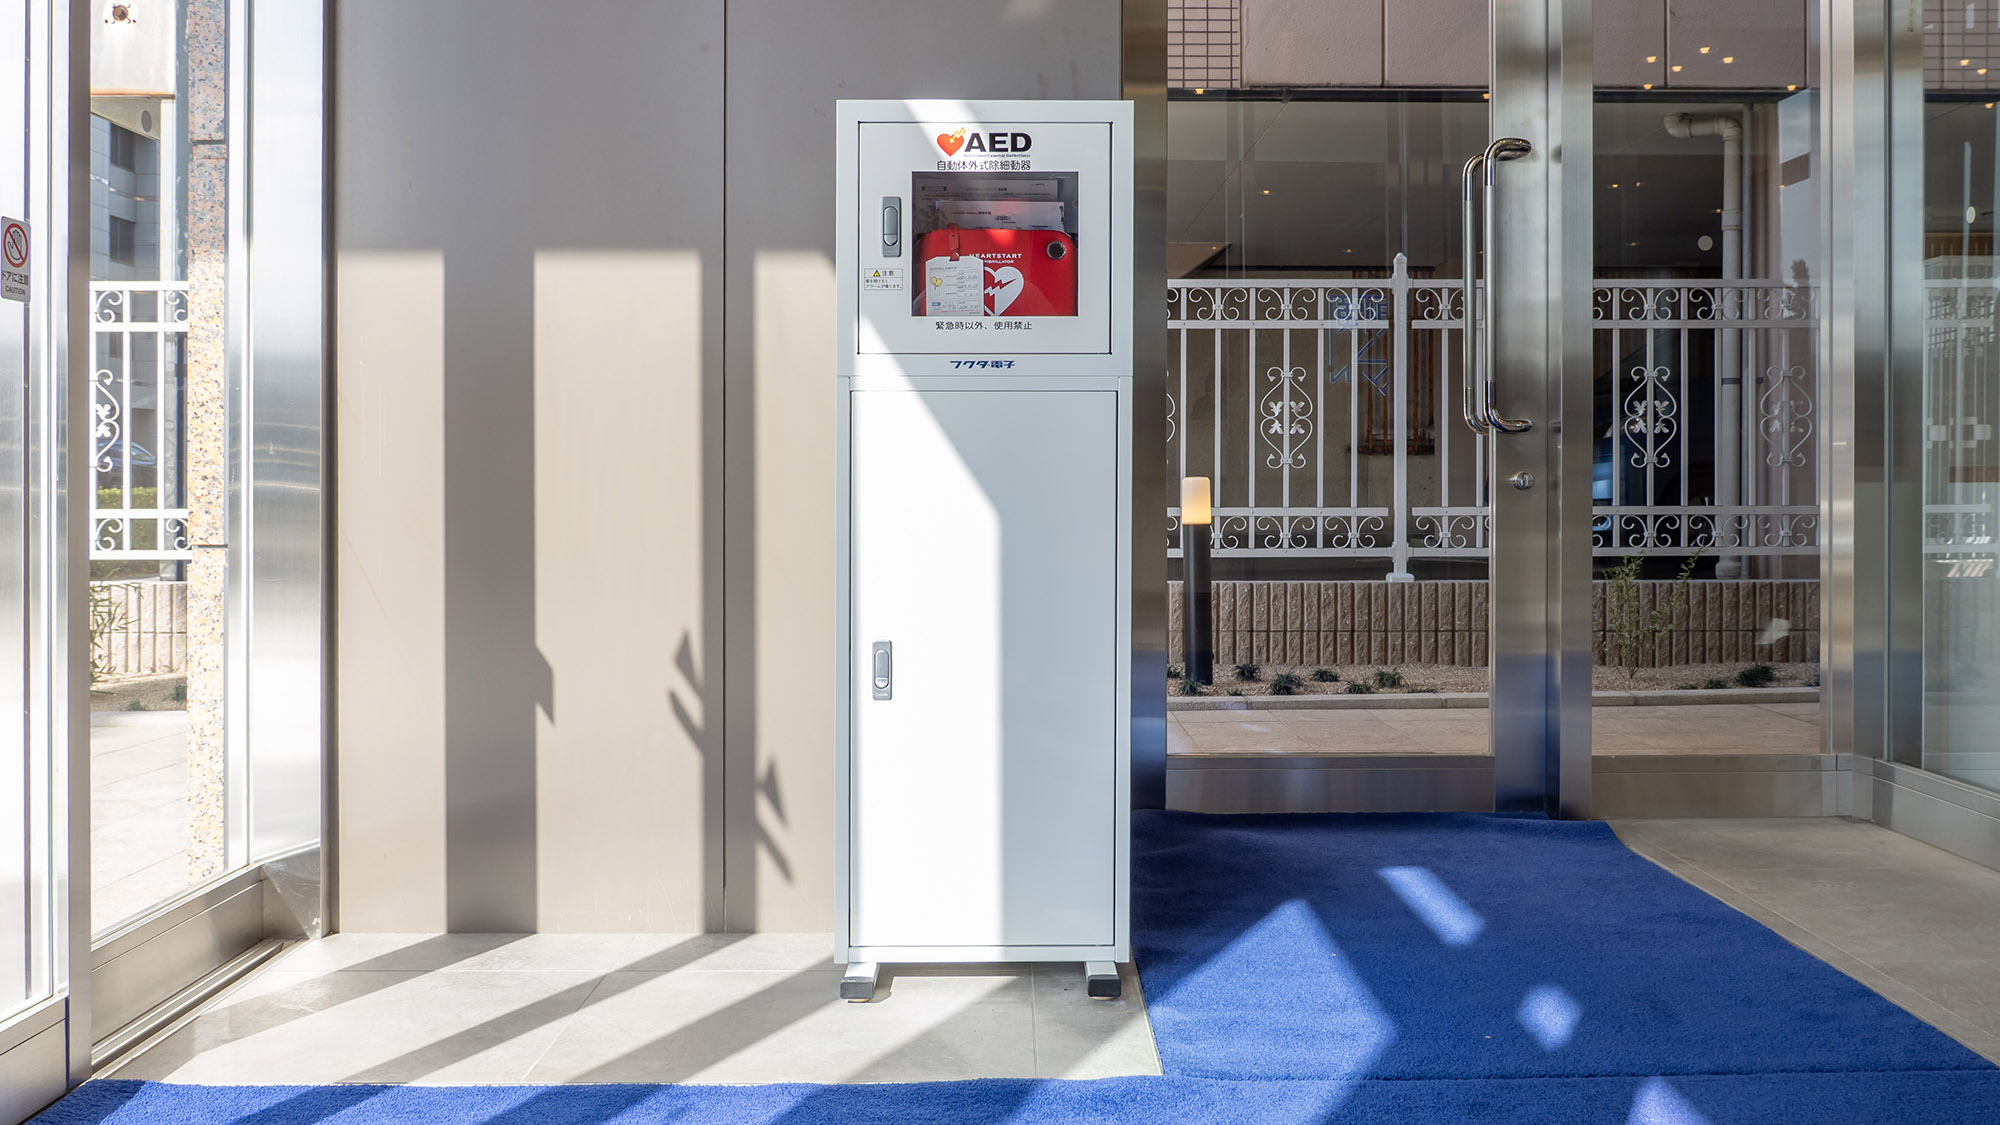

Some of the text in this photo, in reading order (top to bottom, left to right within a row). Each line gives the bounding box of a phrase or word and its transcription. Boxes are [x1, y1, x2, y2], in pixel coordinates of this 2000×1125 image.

[964, 132, 1032, 152] AED
[937, 160, 1031, 171] 自動体外式除細動器
[5, 286, 26, 295] CAUTION
[935, 321, 1032, 331] 緊急時以外、使用禁止
[950, 360, 1015, 369] フクダ電子
